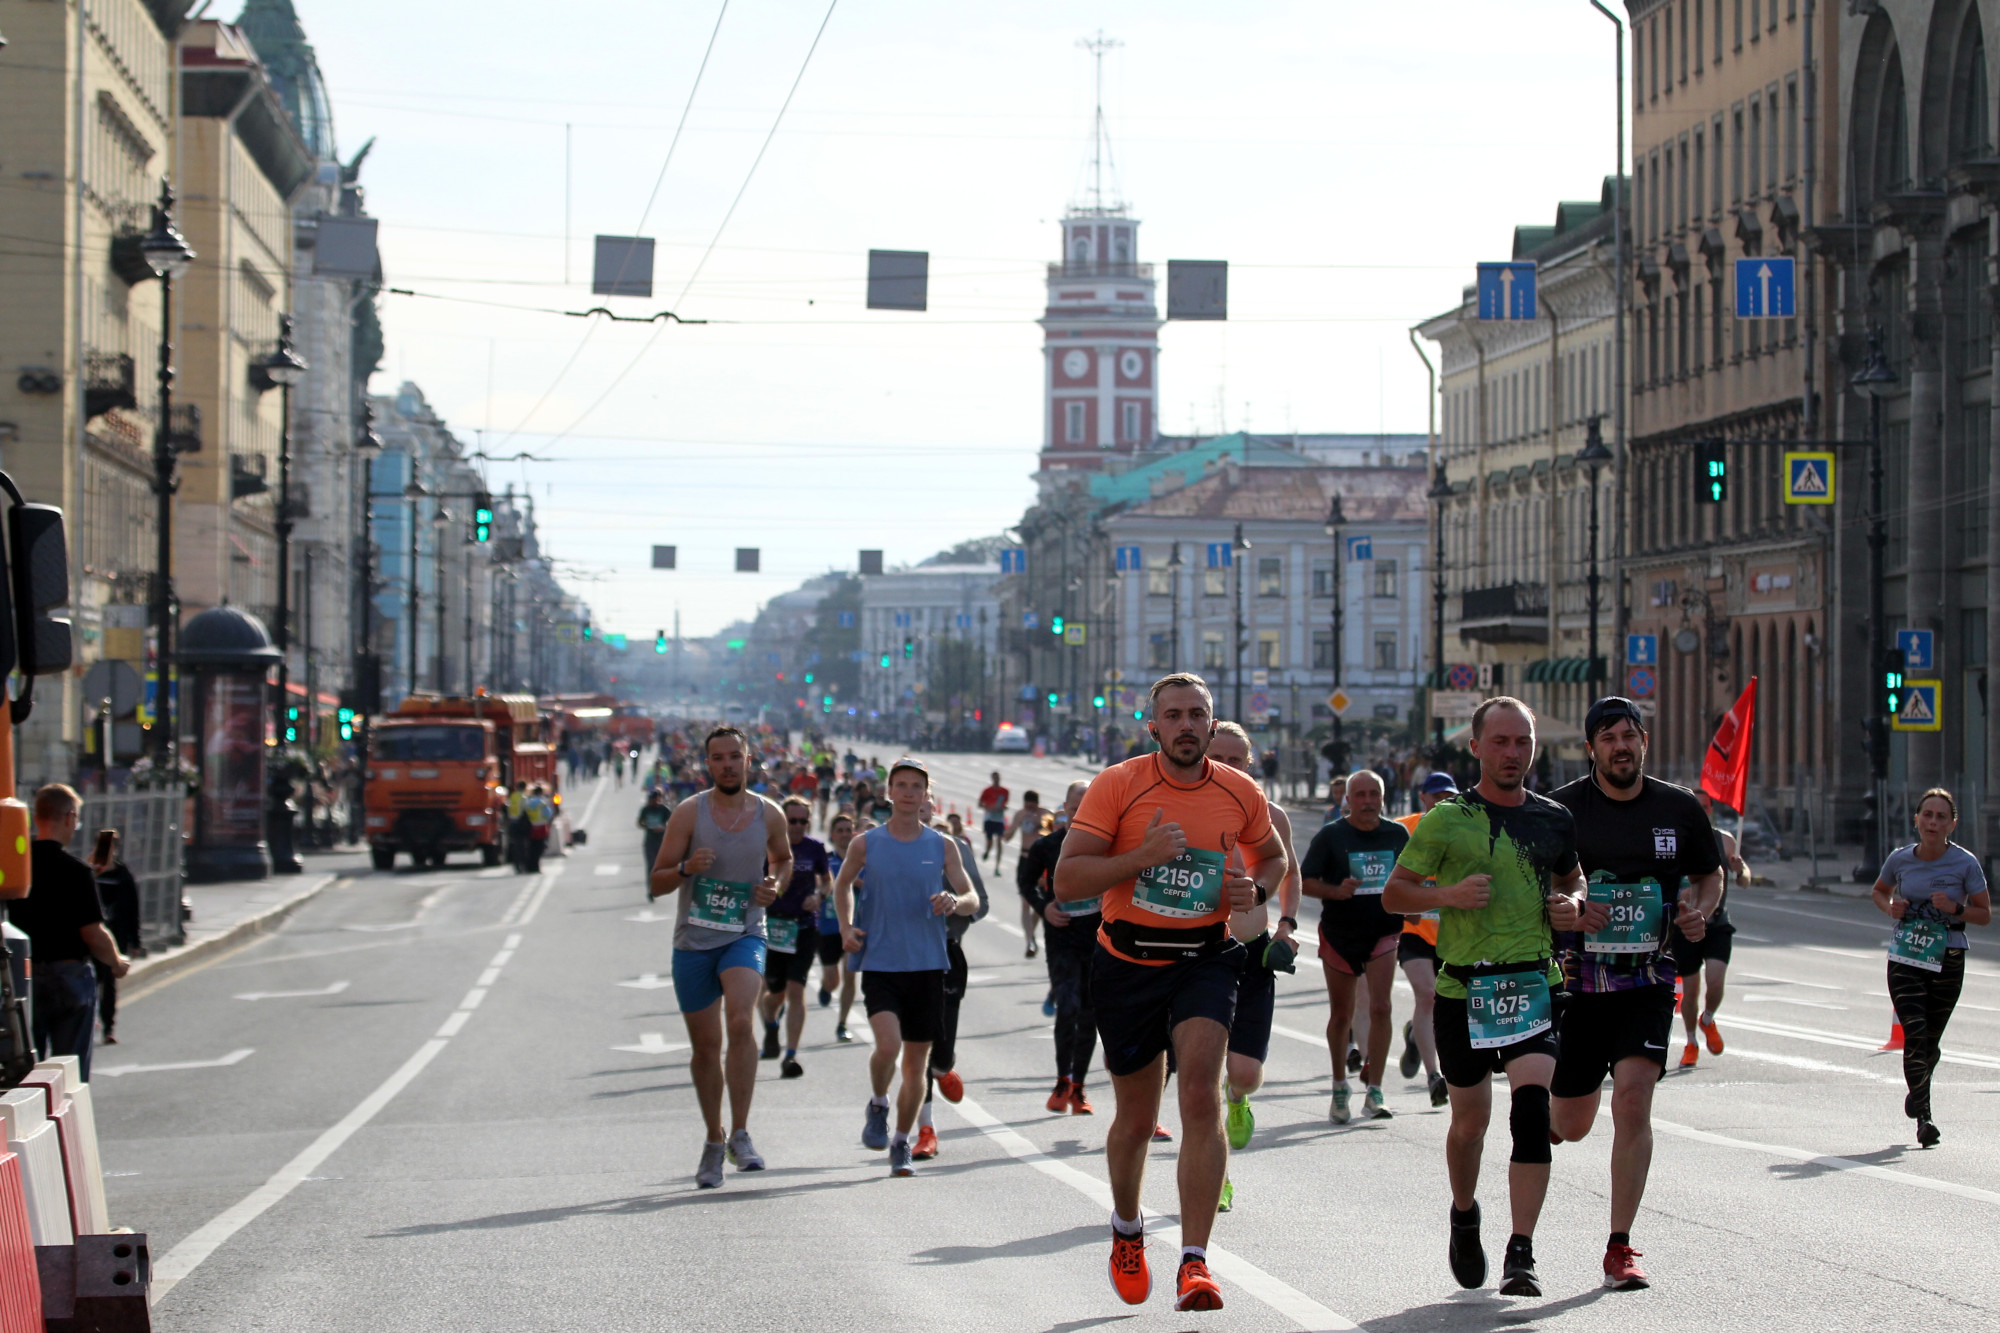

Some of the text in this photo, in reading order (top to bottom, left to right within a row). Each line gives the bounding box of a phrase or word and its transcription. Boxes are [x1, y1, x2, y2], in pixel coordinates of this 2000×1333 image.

[1655, 836, 1676, 851] EA
[1156, 866, 1204, 889] 2150
[1361, 864, 1386, 876] 1672
[1162, 888, 1191, 898] СЕРГЕЙ
[705, 893, 736, 909] 1546
[1904, 931, 1935, 948] 2147
[1487, 994, 1530, 1015] 1675
[1495, 1015, 1524, 1025] СЕРГЕЙ
